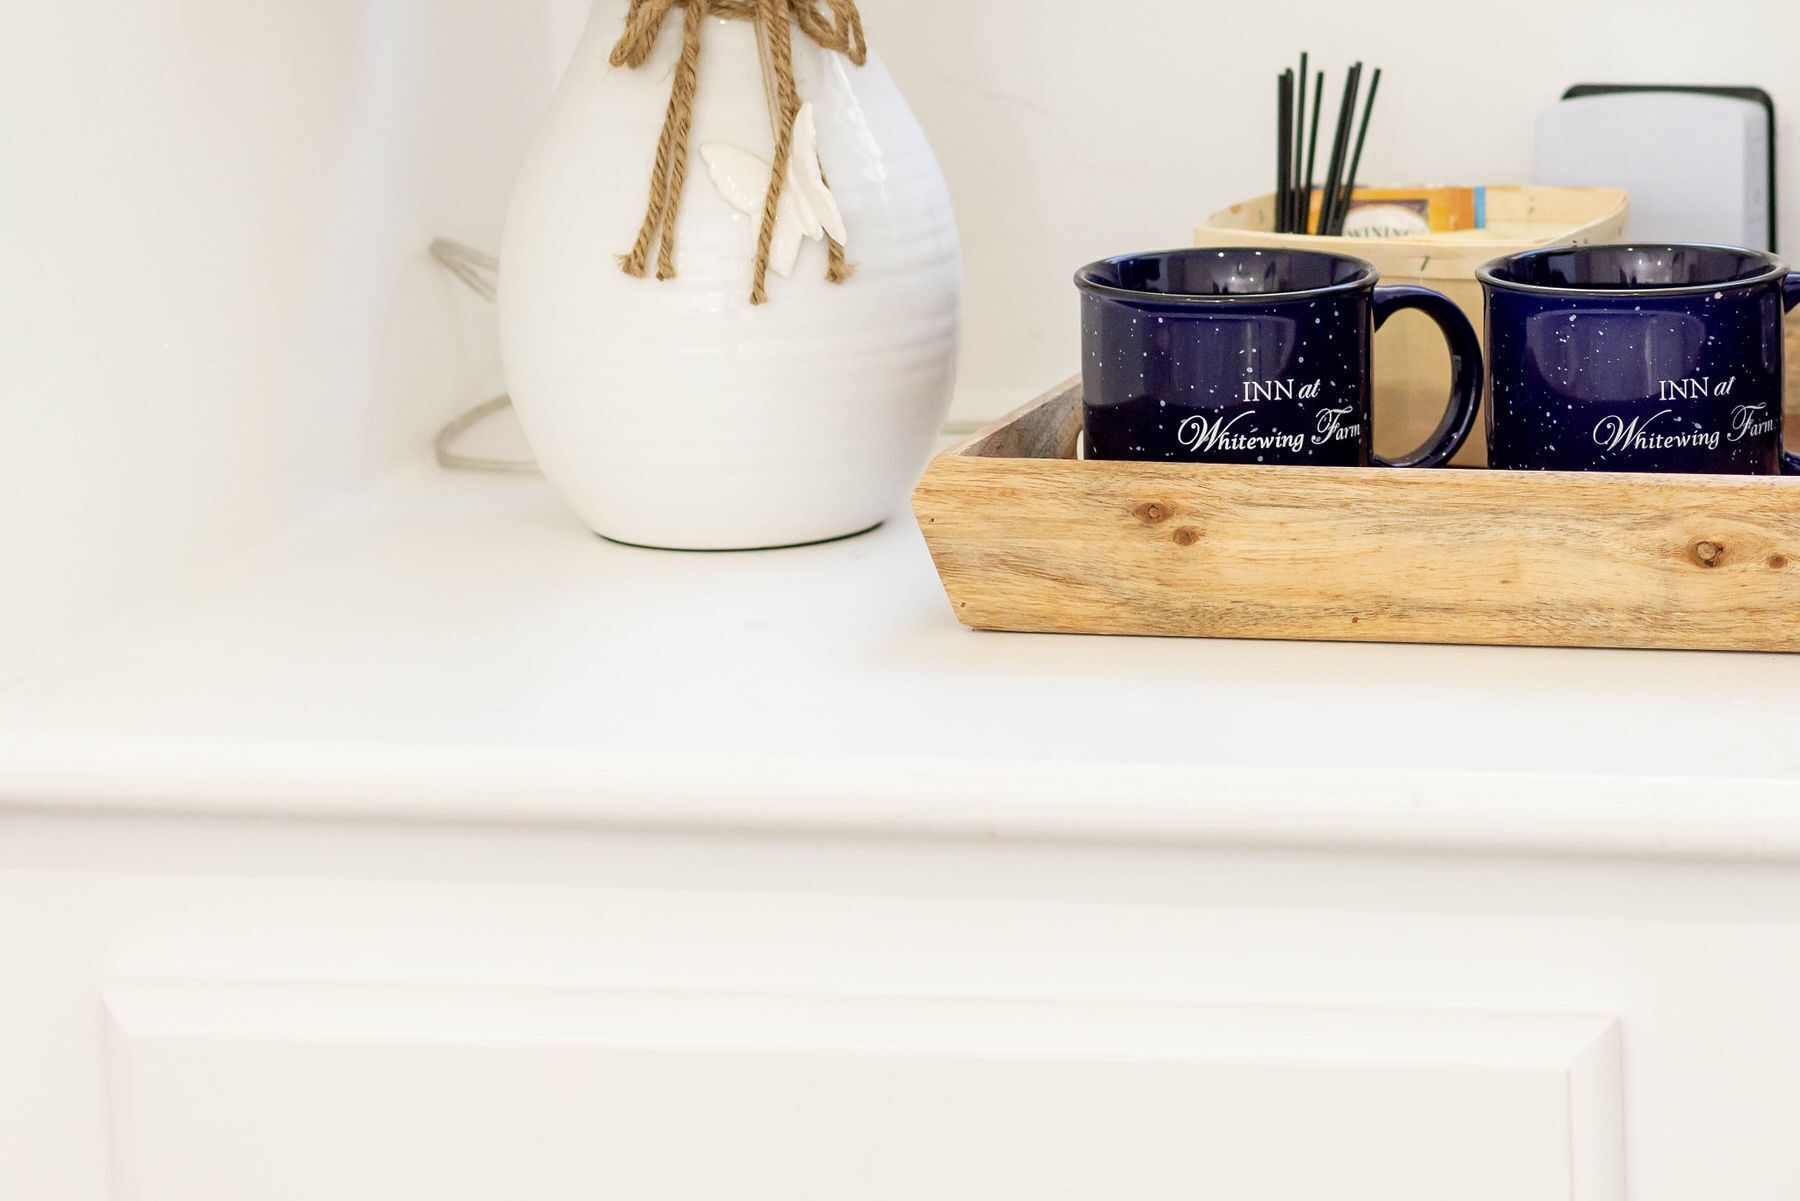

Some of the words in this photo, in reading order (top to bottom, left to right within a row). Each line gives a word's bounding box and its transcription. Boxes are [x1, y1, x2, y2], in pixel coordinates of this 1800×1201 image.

[1242, 378, 1295, 402] INN
[1298, 378, 1321, 400] at
[1658, 376, 1710, 401] INN
[1713, 375, 1736, 397] at
[1177, 410, 1305, 453] Whitewing
[1310, 405, 1361, 445] Farm
[1592, 409, 1720, 451] Whitewing
[1726, 401, 1774, 442] Farm
